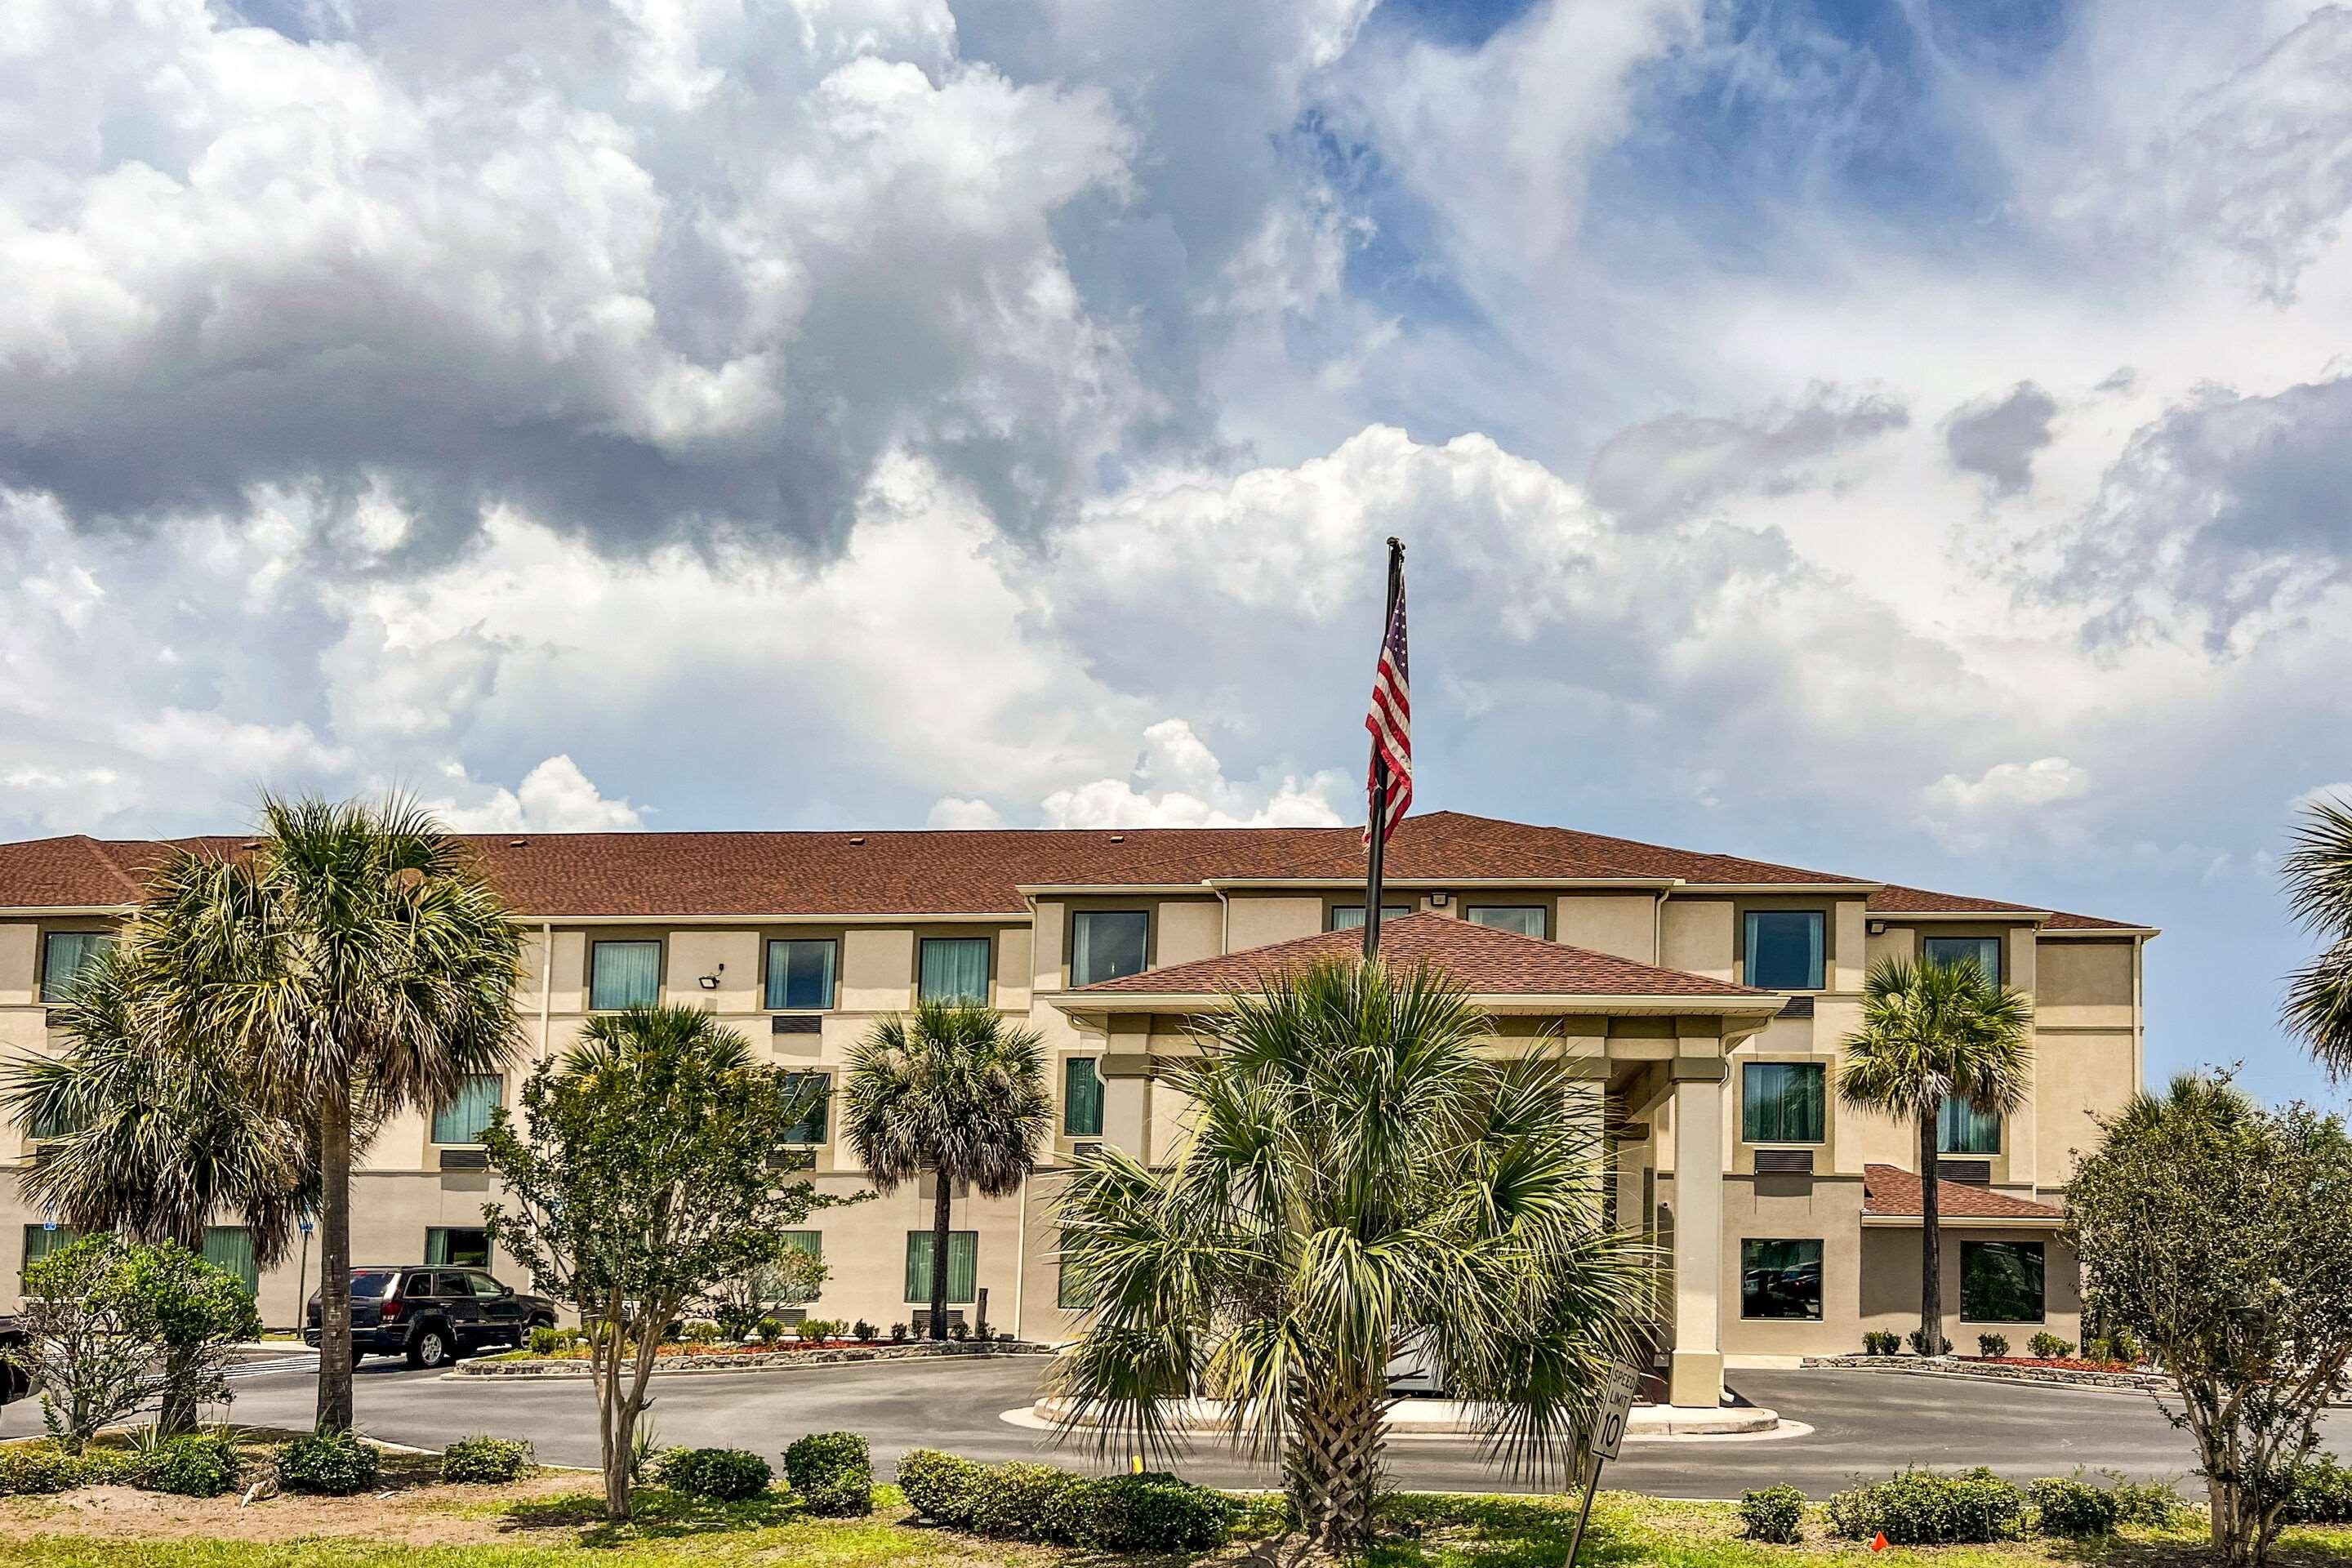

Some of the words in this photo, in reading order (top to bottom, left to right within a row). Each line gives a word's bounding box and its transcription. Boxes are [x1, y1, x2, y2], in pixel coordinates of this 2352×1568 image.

[1612, 1369, 1636, 1390] SPEED
[1609, 1390, 1628, 1409] LIMIT
[1600, 1411, 1620, 1447] 10
